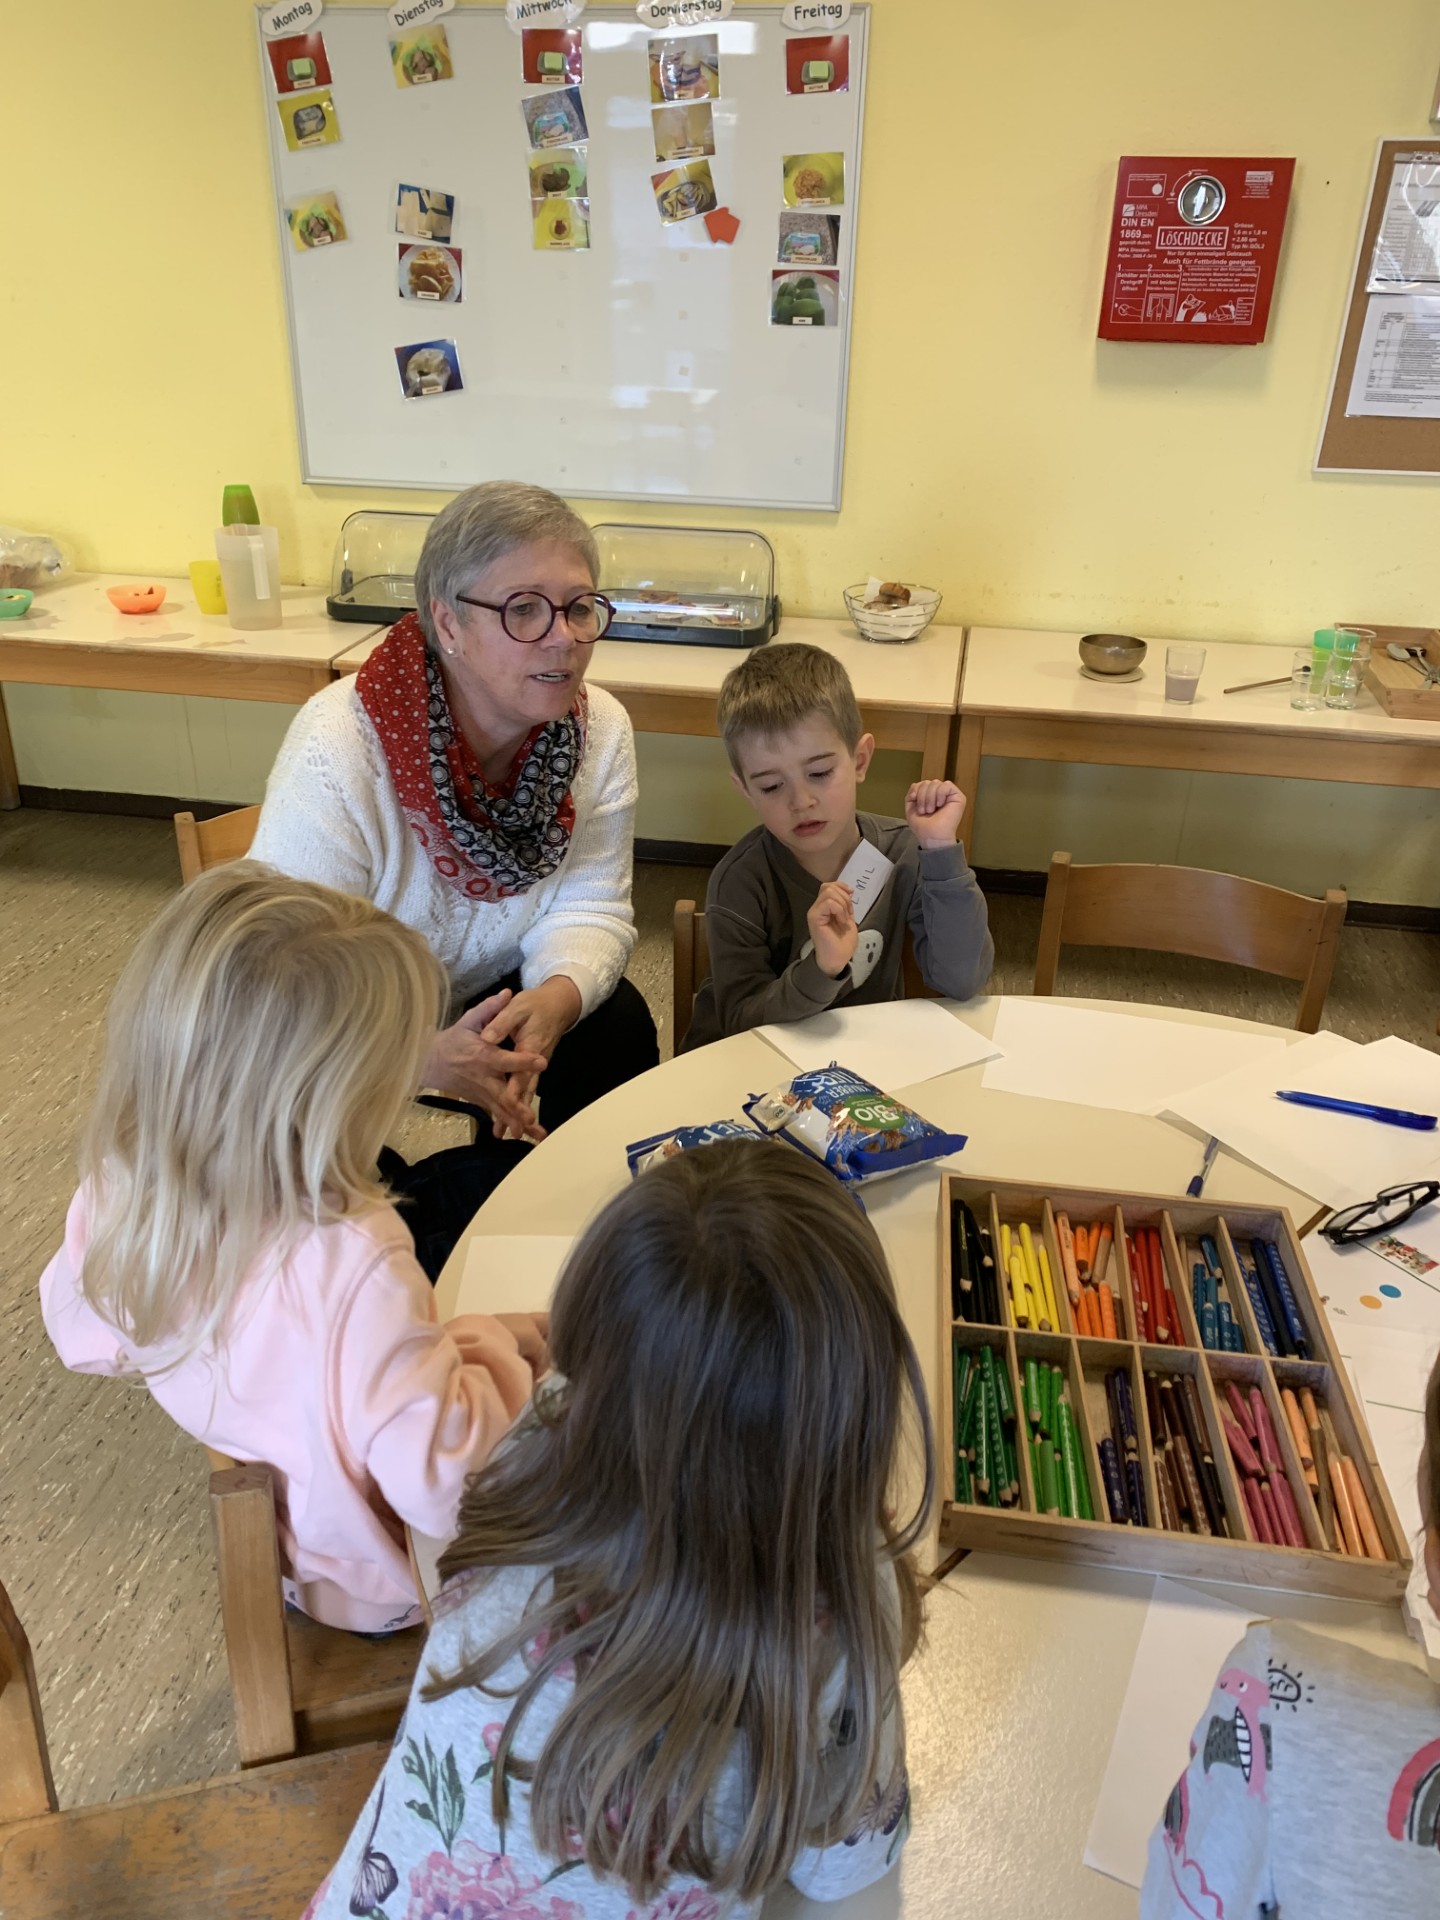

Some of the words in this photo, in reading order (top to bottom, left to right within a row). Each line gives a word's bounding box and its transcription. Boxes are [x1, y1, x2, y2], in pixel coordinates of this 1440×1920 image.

[272, 2, 313, 31] Montag
[393, 0, 444, 27] Dienstag
[794, 3, 843, 20] Freitag
[1121, 218, 1138, 226] DIN
[1140, 218, 1154, 227] EN
